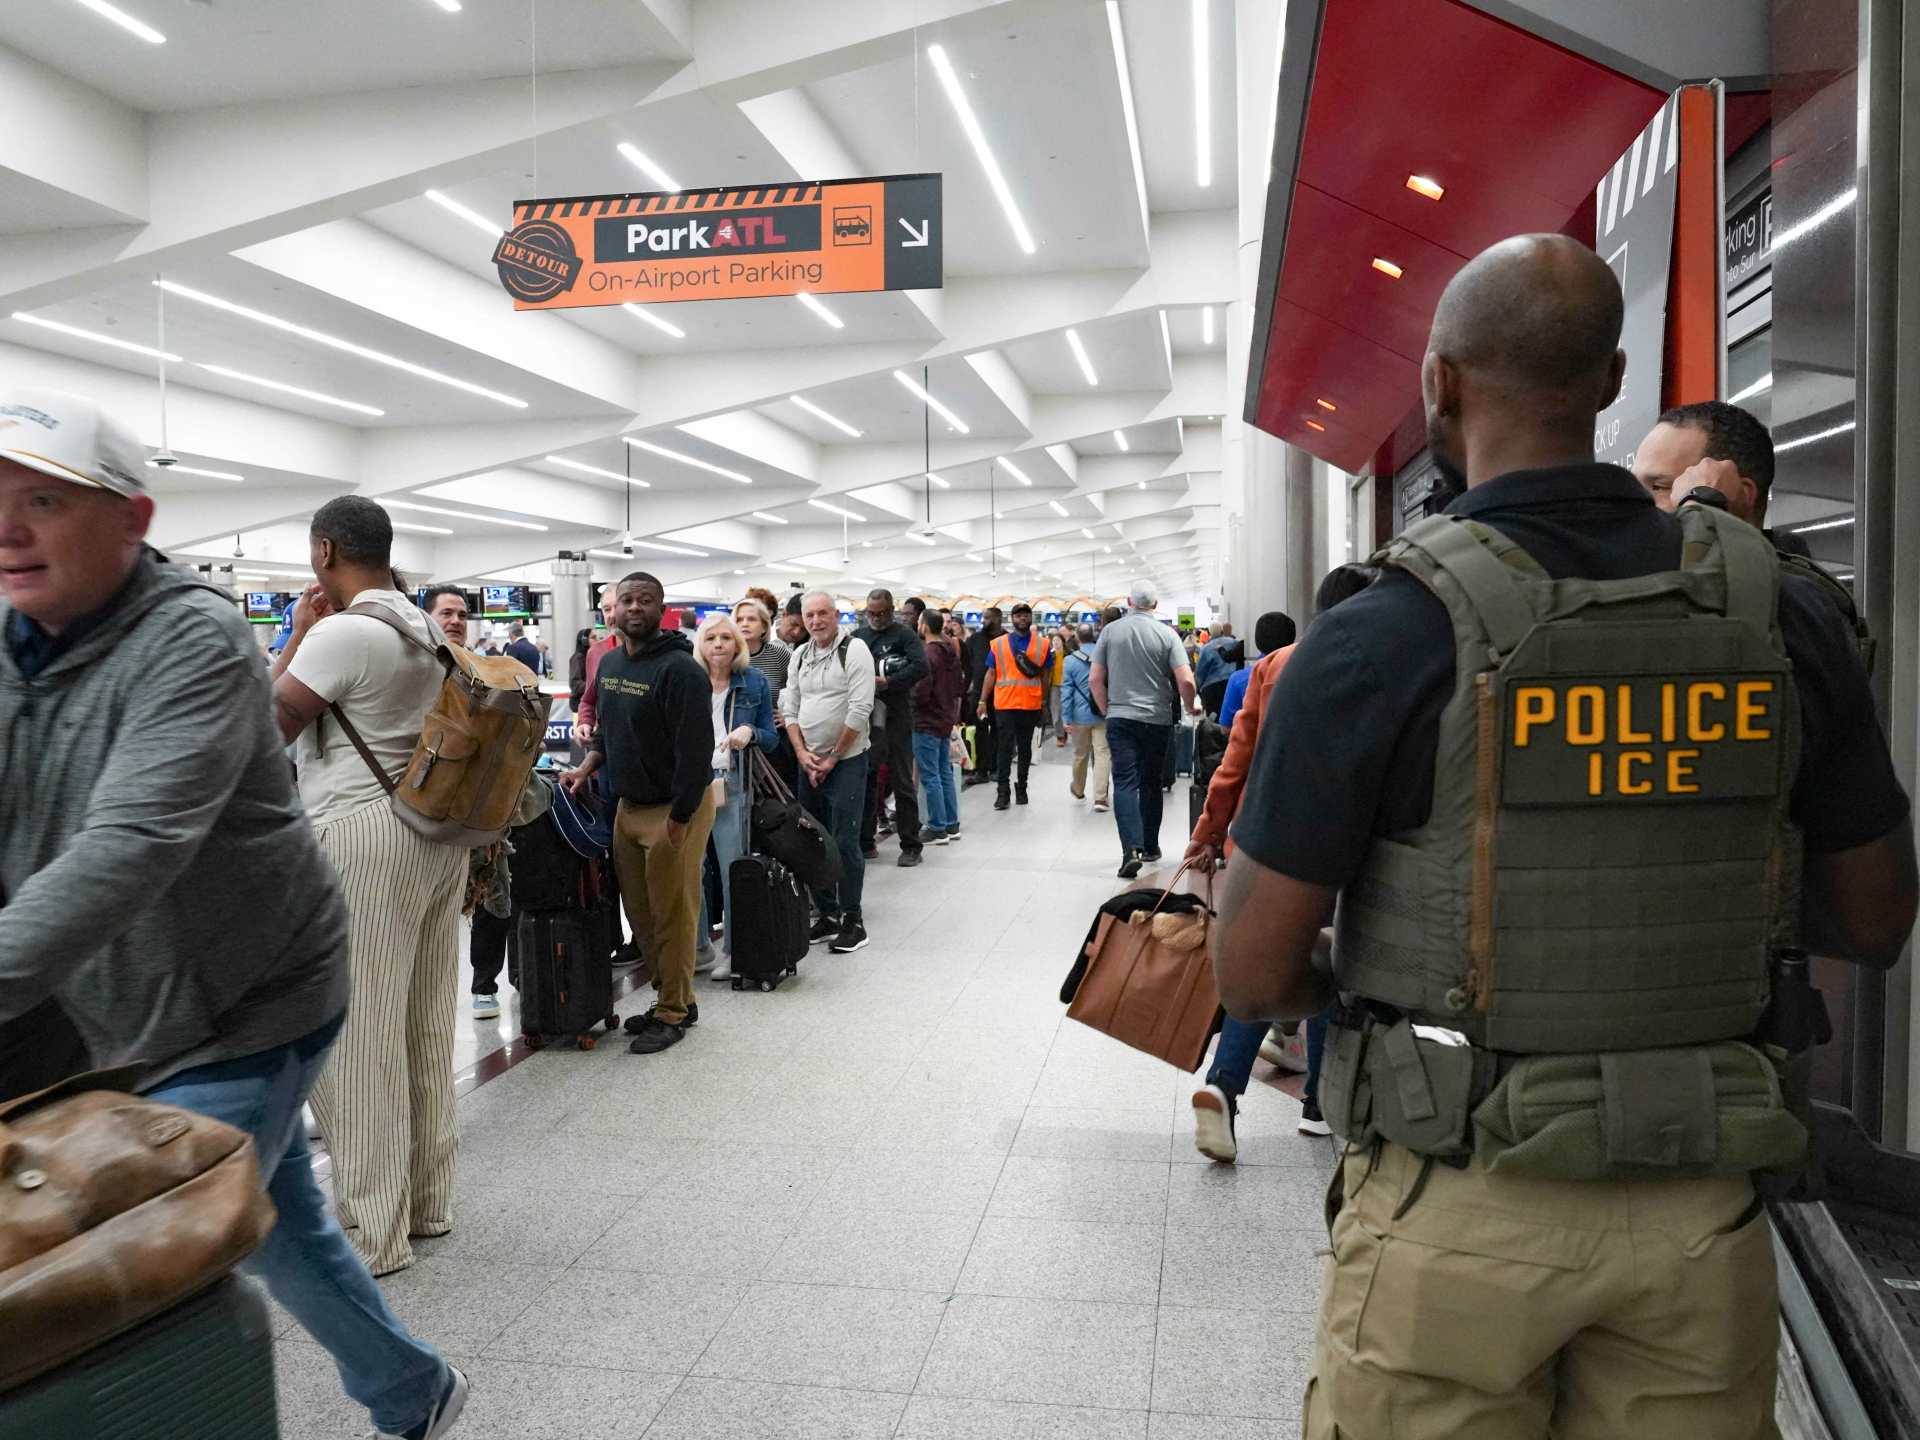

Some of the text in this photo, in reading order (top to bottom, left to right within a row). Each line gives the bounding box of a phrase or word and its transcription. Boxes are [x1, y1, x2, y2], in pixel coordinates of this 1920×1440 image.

[627, 215, 786, 253] ParkATL
[504, 243, 569, 277] DETOUR
[588, 259, 822, 292] On-Airport Parking
[1608, 419, 1620, 448] UP
[1514, 681, 1773, 747] POLICE
[544, 725, 567, 739] RST
[1588, 750, 1700, 796] ICE
